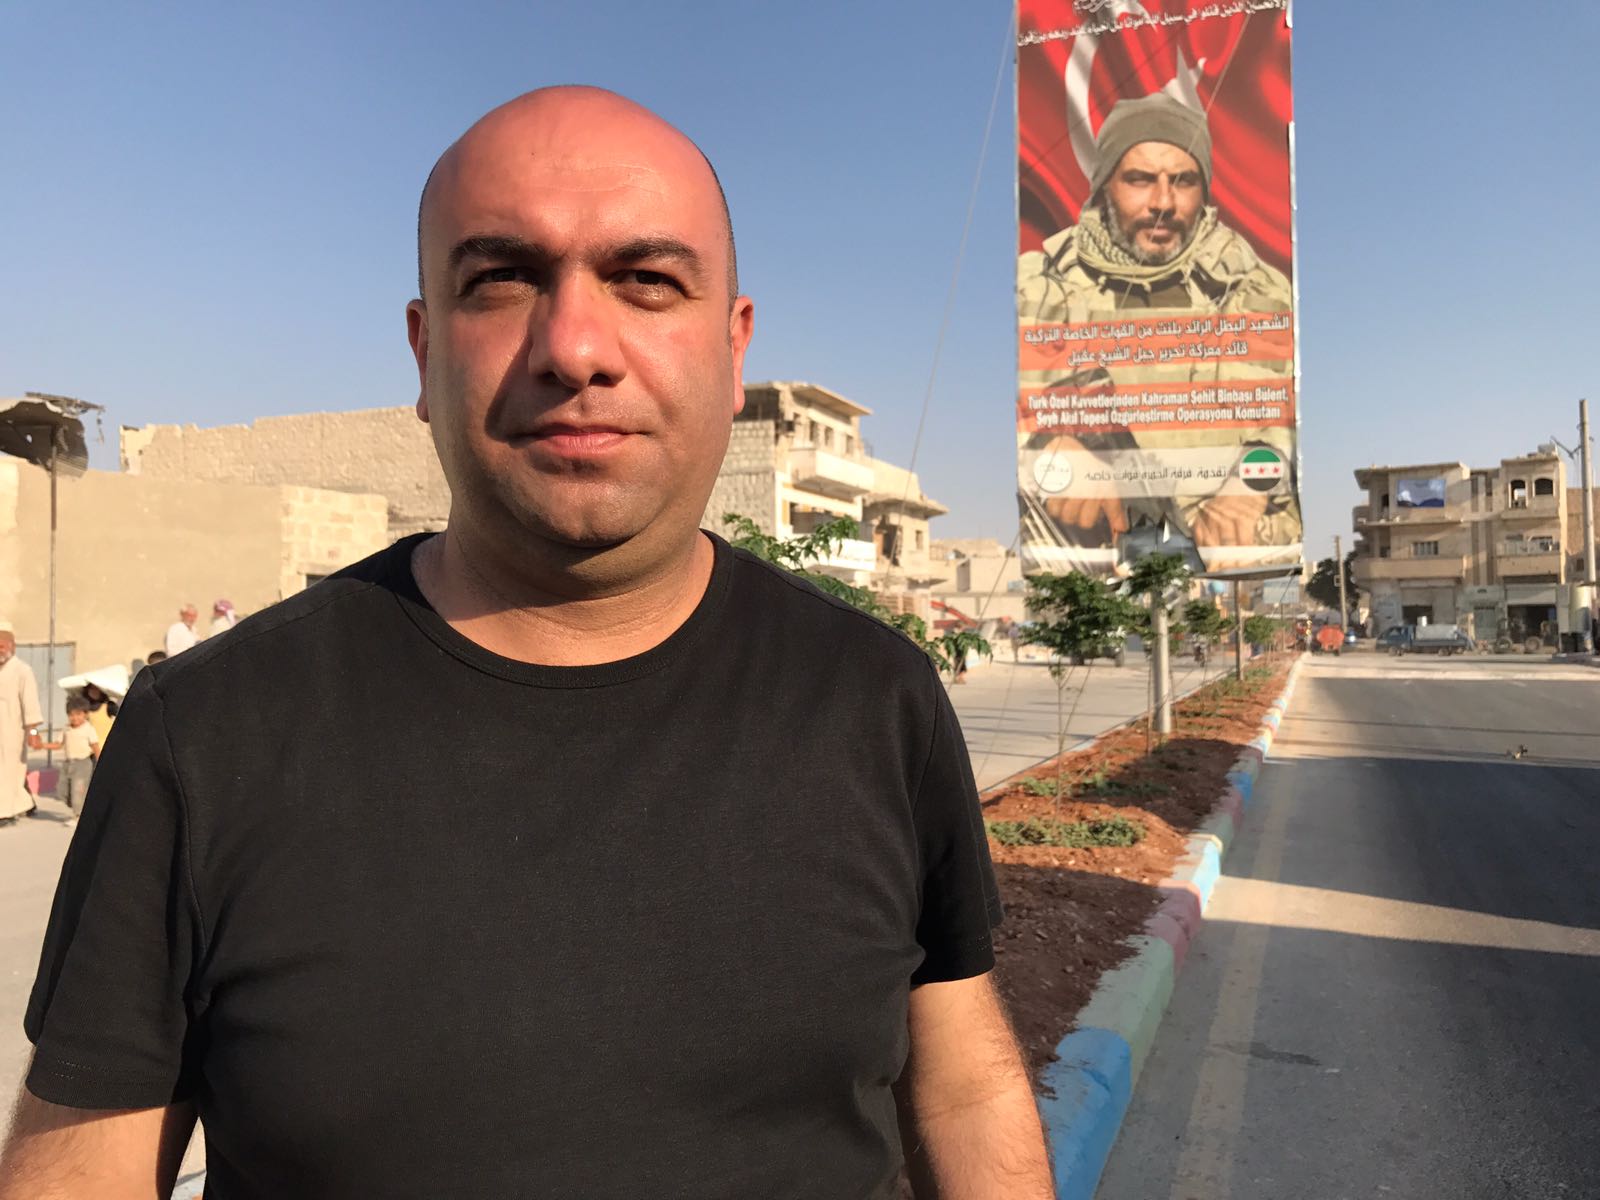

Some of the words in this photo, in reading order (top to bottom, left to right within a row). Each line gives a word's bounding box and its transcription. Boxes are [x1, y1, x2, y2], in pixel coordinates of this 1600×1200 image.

[1100, 322, 1135, 341] القوات
[1137, 325, 1154, 340] من
[1214, 316, 1247, 337] البطل
[1249, 314, 1289, 335] الشهيد
[1098, 346, 1131, 369] الشيخ
[1188, 343, 1222, 360] معركة
[1141, 391, 1189, 406] Kahraman
[1079, 409, 1110, 427] Tepesi
[1176, 406, 1234, 424] Operasyonu
